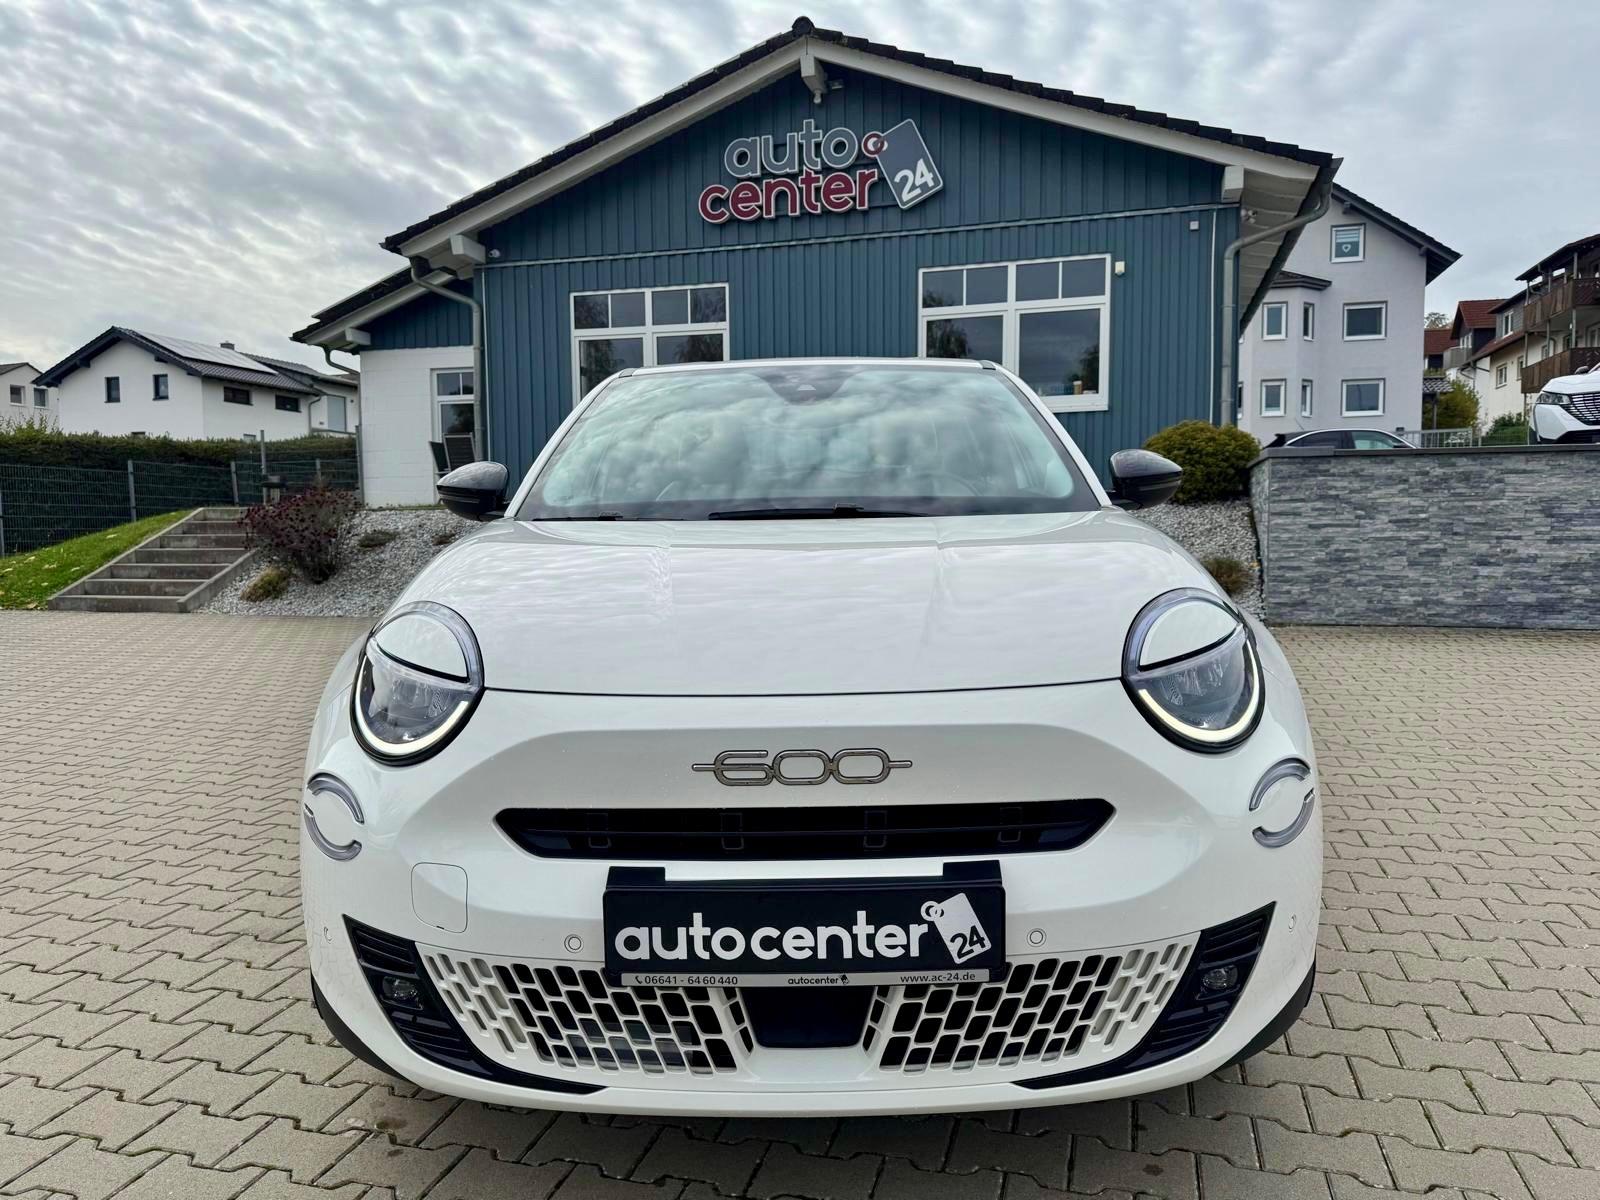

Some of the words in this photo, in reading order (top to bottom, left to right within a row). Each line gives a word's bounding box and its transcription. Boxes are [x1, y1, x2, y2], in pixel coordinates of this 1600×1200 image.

[724, 118, 858, 178] auto
[698, 165, 878, 224] center
[894, 158, 934, 203] 24
[713, 747, 892, 787] 600
[950, 925, 986, 960] 24
[787, 976, 839, 985] autocenter
[900, 972, 976, 984] www.ac-24.de
